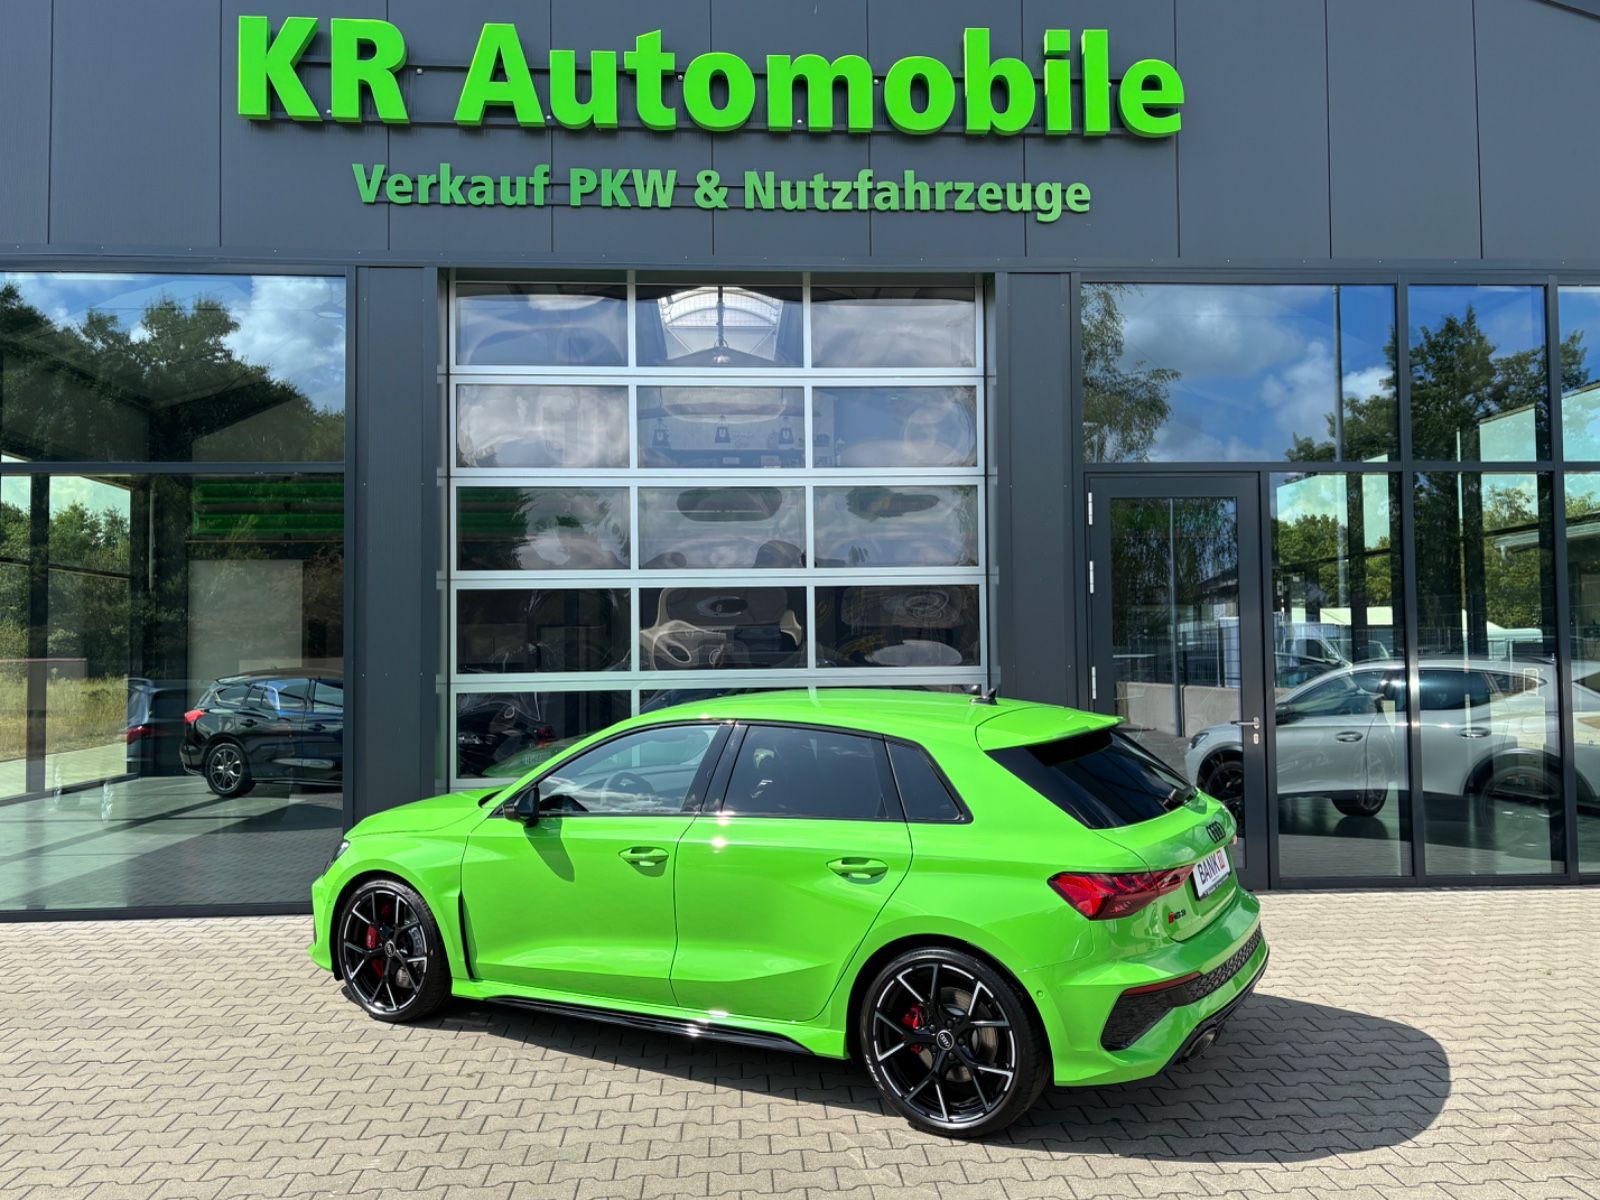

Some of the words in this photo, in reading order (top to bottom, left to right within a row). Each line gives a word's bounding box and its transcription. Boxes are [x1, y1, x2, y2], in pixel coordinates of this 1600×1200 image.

[237, 15, 410, 124] KR
[453, 22, 1186, 138] Automobile
[351, 163, 551, 207] Verkauf
[569, 168, 678, 209] PKW
[693, 169, 730, 210] &
[743, 169, 1092, 223] Nutzfahrzeuge
